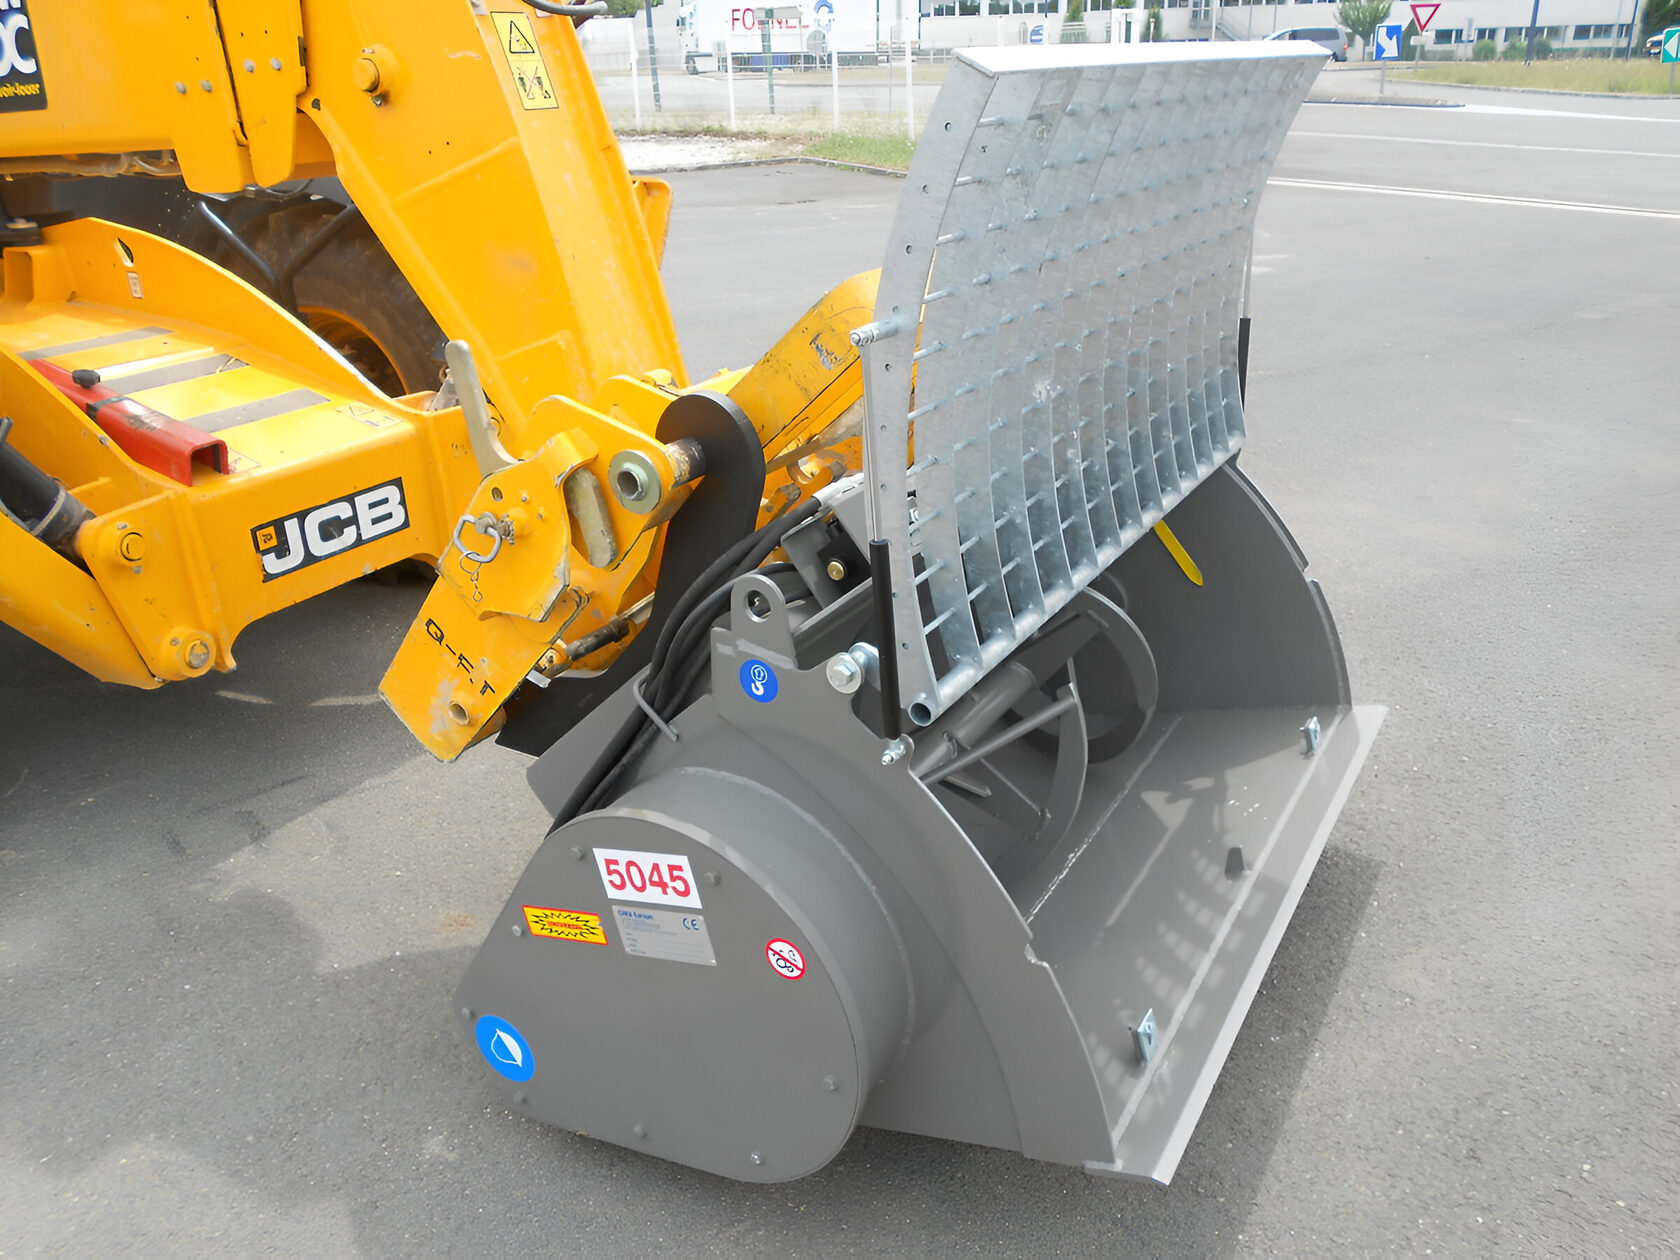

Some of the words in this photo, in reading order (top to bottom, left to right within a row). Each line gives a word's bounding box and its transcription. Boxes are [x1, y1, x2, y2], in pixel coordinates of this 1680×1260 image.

[262, 485, 405, 574] JCB
[425, 617, 496, 696] Q-FT
[603, 858, 691, 898] 5045
